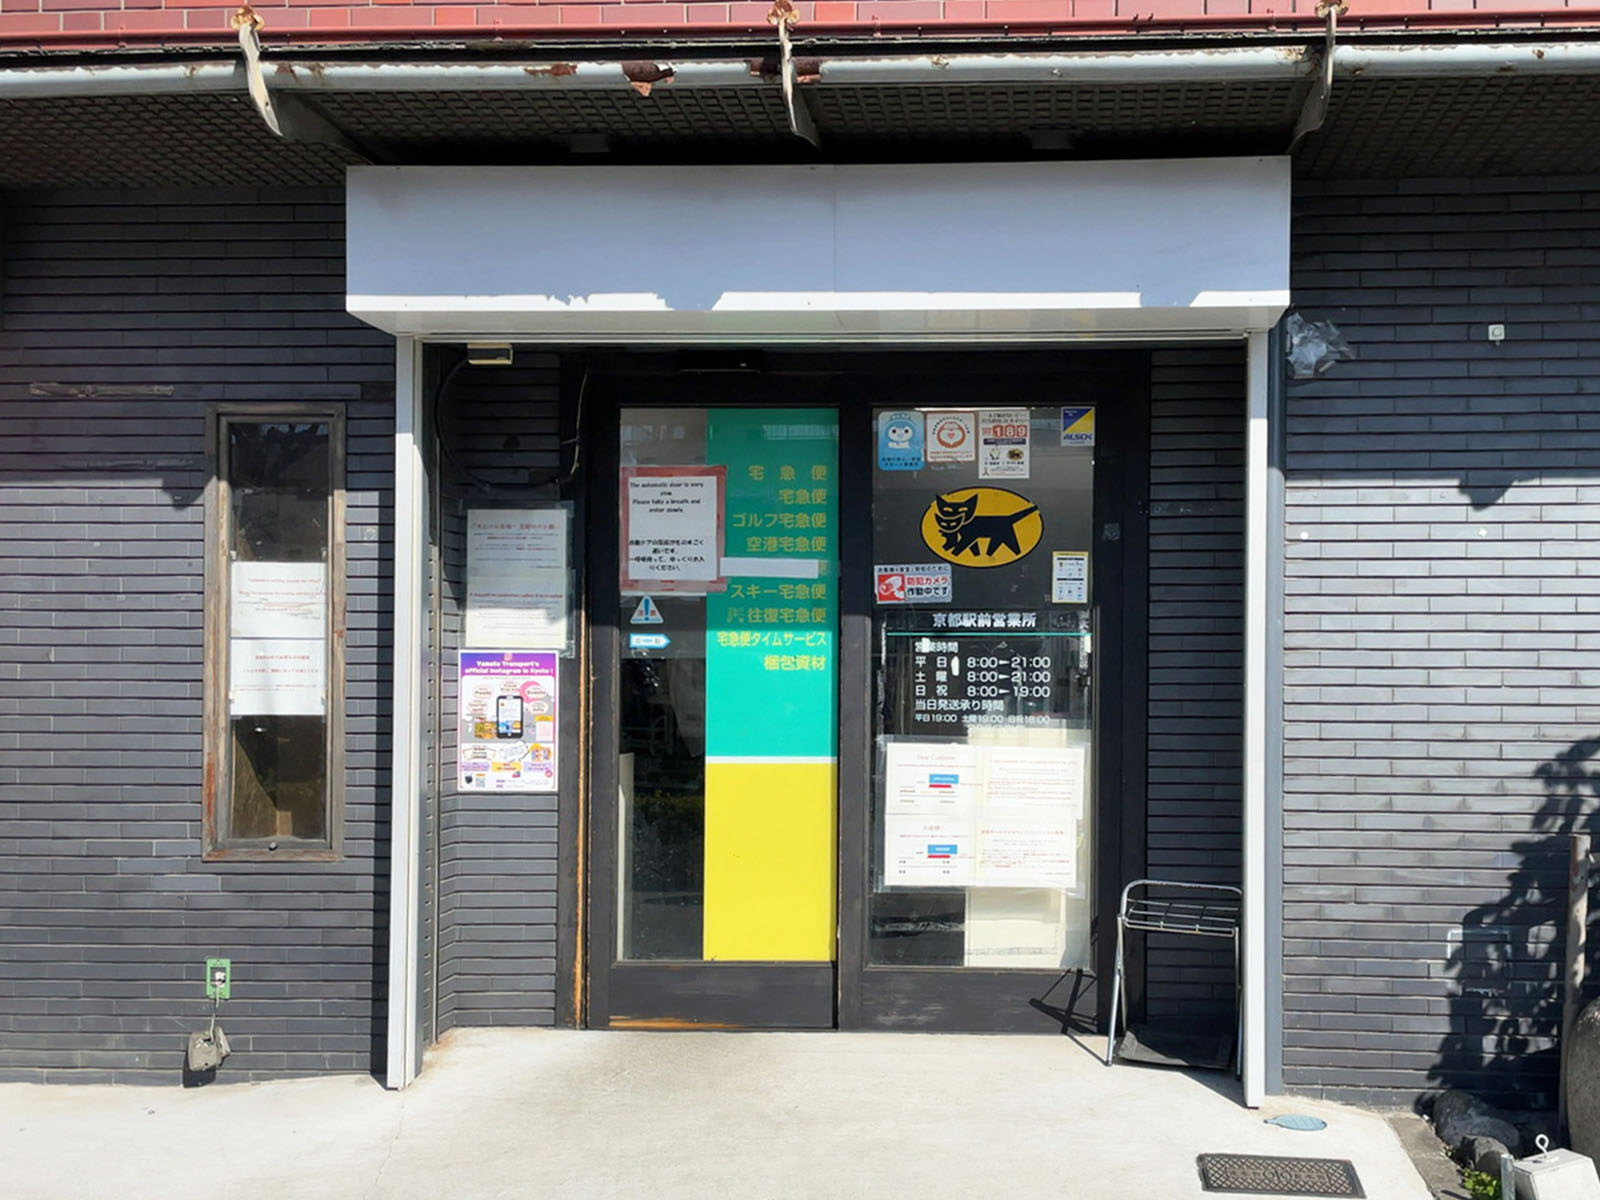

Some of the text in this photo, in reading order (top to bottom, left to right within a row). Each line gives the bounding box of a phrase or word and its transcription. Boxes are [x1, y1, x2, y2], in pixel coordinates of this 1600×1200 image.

[994, 425, 1026, 437] 189
[779, 488, 826, 504] 宅急便
[732, 512, 826, 528] ゴルフ宅急便
[746, 535, 826, 552] 空港宅急便
[907, 576, 948, 586] 防犯カメラ
[730, 583, 826, 599] スキー宅急便
[907, 586, 948, 596] 作動中です
[933, 613, 1037, 628] 京都駅前営業所
[717, 632, 826, 647] 宅急便タイムサービス
[764, 655, 826, 671] 梱包資材
[915, 699, 1005, 712] 当日発送承り時間
